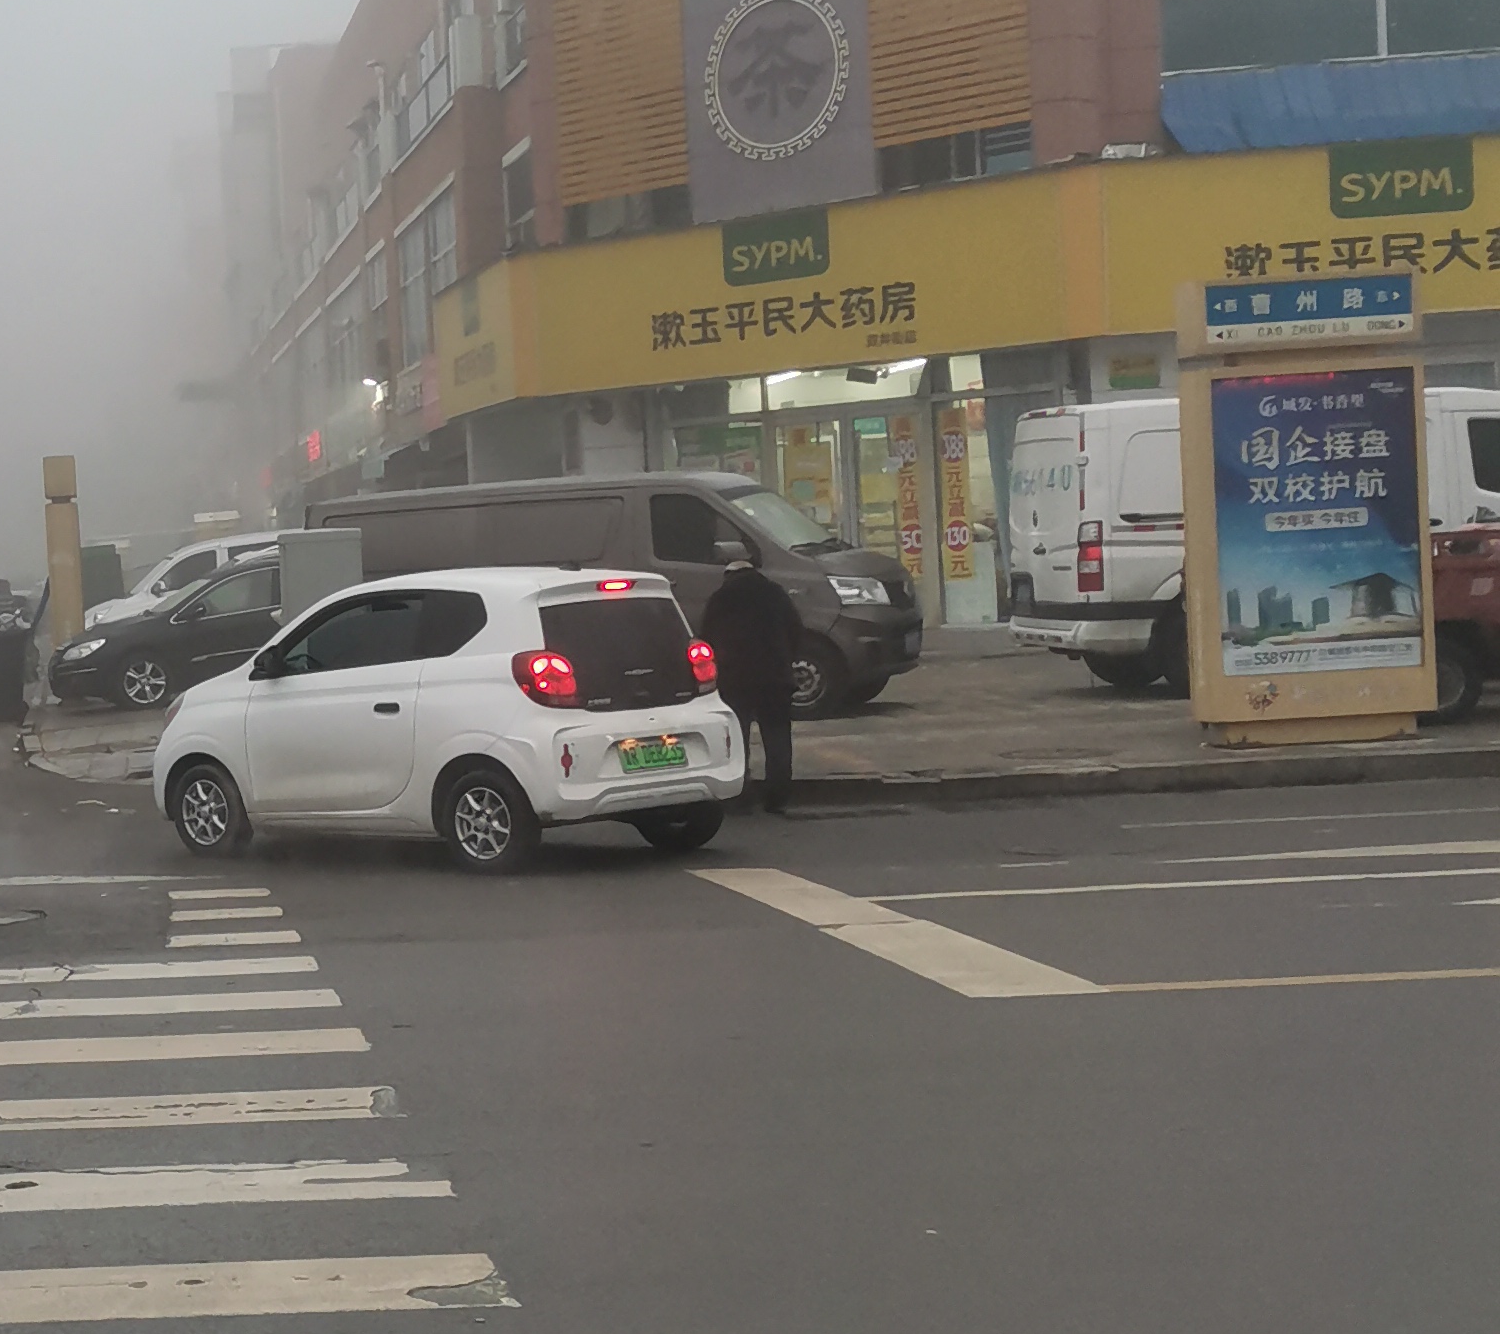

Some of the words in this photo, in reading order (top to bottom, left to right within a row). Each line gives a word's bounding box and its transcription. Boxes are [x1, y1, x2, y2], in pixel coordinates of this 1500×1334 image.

[1339, 167, 1463, 203] SYPM.
[731, 235, 823, 272] SYPM.
[651, 281, 917, 351] 漱玉平民大药房
[1291, 322, 1326, 336] ZHOU
[1241, 425, 1391, 471] 国企接盘
[1248, 467, 1388, 504] 双校护航
